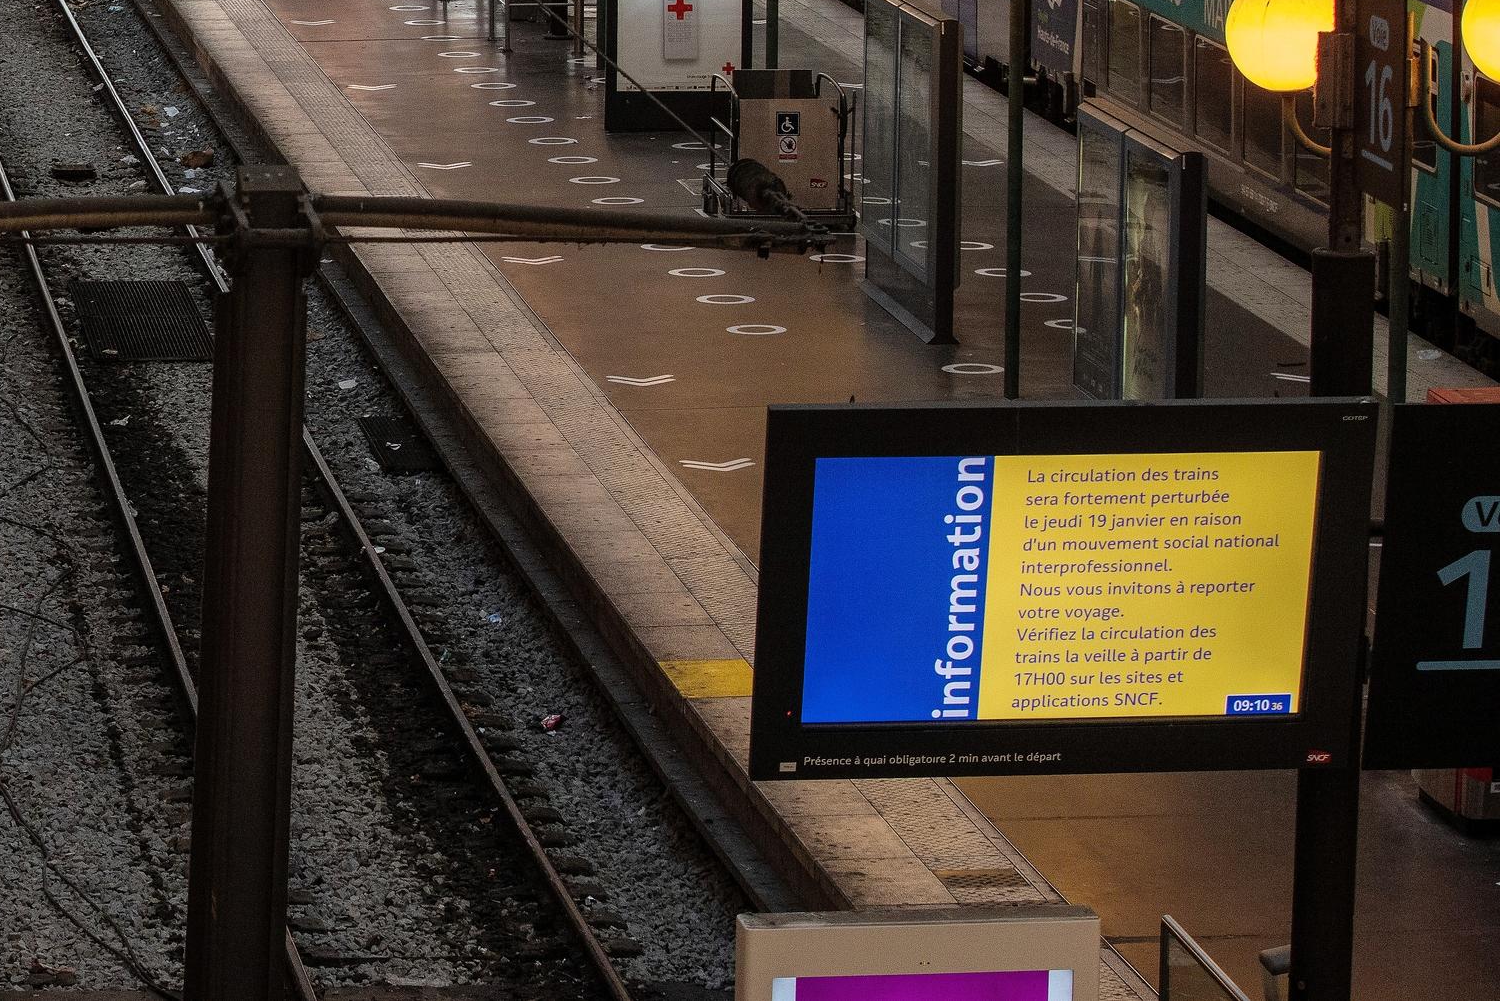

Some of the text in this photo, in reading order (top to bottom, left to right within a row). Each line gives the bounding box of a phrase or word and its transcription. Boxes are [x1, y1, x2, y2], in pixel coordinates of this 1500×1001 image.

[1364, 59, 1393, 152] 16
[1027, 467, 1219, 483] La circulation des trains
[1025, 489, 1230, 508] sera fortement perturbée
[1024, 513, 1242, 532] le jeudi 19 janvier en raison
[1022, 533, 1280, 552] d'un mouvement social national
[1021, 558, 1173, 578] interprofessionnel.
[932, 456, 986, 719] information
[1020, 580, 1256, 597] Nous vous invitons à reporter
[1018, 607, 1125, 622] votre voyage.
[1016, 624, 1217, 642] Vérifiez la circulation des
[1014, 646, 1212, 665] trains la veille à partir de
[1013, 670, 1184, 686] 17H00 sur les sites et
[1011, 692, 1163, 709] applications SNCF.
[1233, 699, 1283, 712] 09:10 36
[803, 751, 1063, 768] Présence à quai obligatoire 2 min avant le départ
